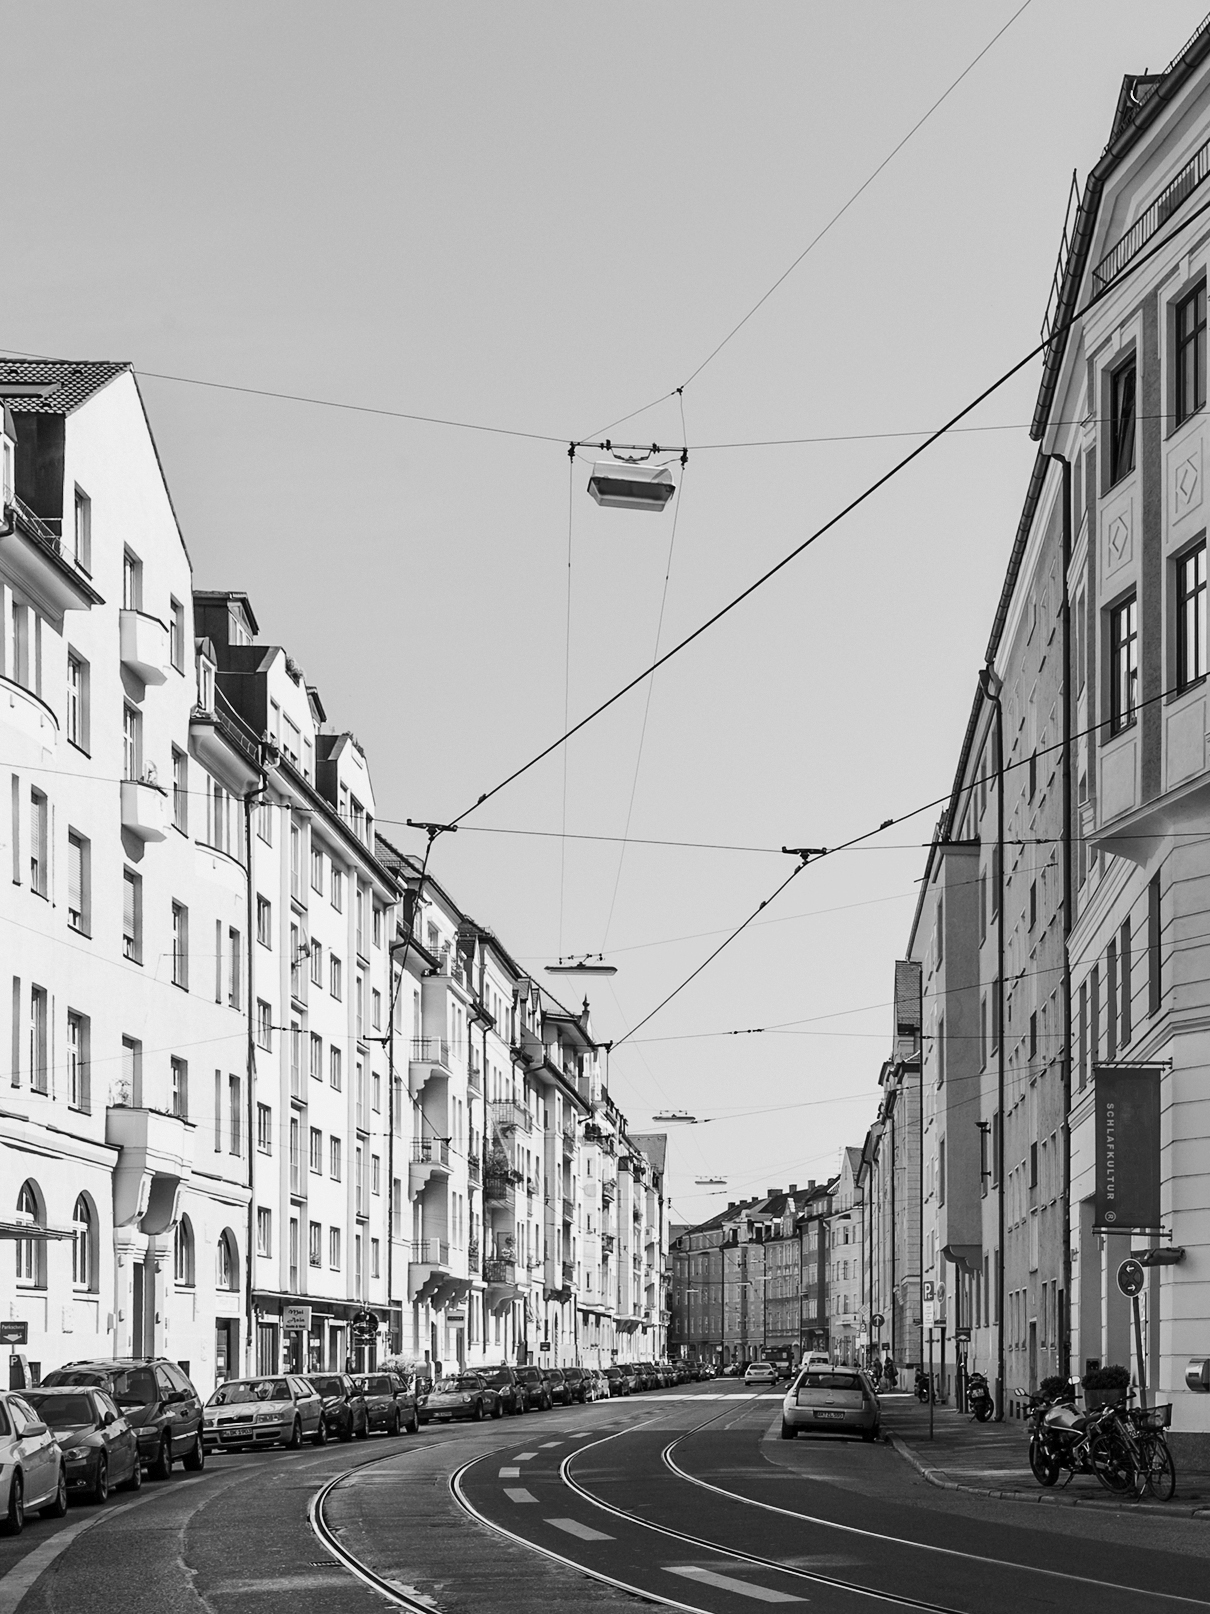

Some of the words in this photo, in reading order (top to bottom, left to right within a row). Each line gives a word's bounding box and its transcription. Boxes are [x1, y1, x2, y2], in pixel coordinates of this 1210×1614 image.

[1106, 1103, 1115, 1200] SCHLAFKULTUR
[924, 1283, 932, 1299] P
[10, 1356, 18, 1366] P
